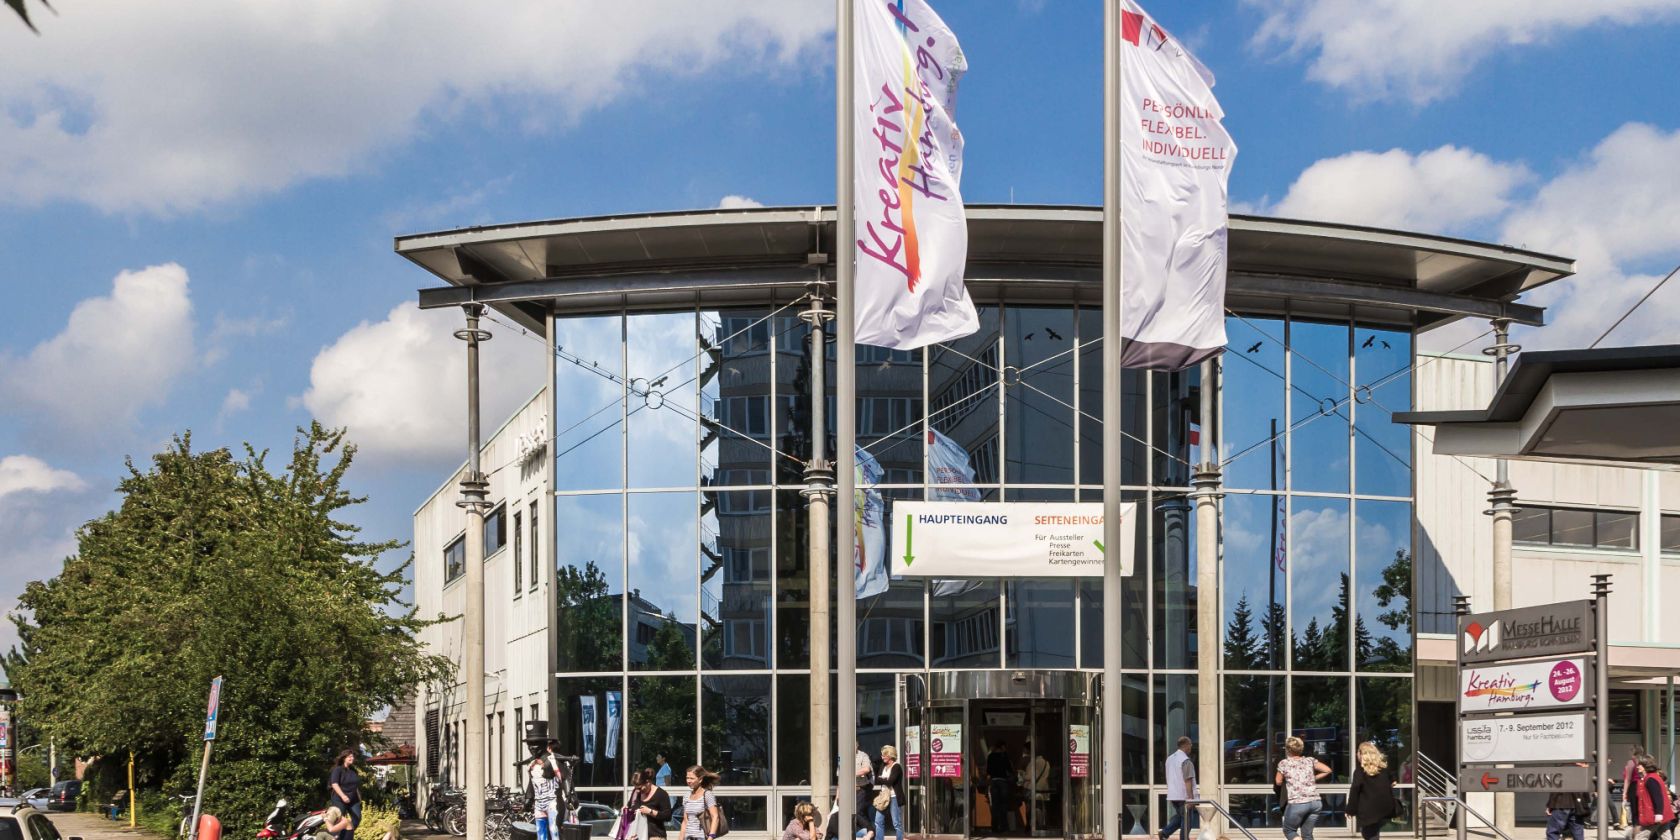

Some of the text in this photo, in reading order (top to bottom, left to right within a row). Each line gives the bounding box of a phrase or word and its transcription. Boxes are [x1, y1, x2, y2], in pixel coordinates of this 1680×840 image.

[1143, 138, 1226, 159] INDIVIDUELL
[857, 81, 914, 279] Kreativ
[919, 514, 1008, 525] HAUPTEINGANG
[1034, 515, 1122, 525] SEITENEINGA
[1468, 670, 1515, 690] Kreativ
[1554, 677, 1575, 685] August
[1558, 686, 1573, 694] 2012
[1517, 723, 1555, 732] September
[1555, 721, 1574, 730] 2012
[1506, 773, 1563, 788] EINGANG
